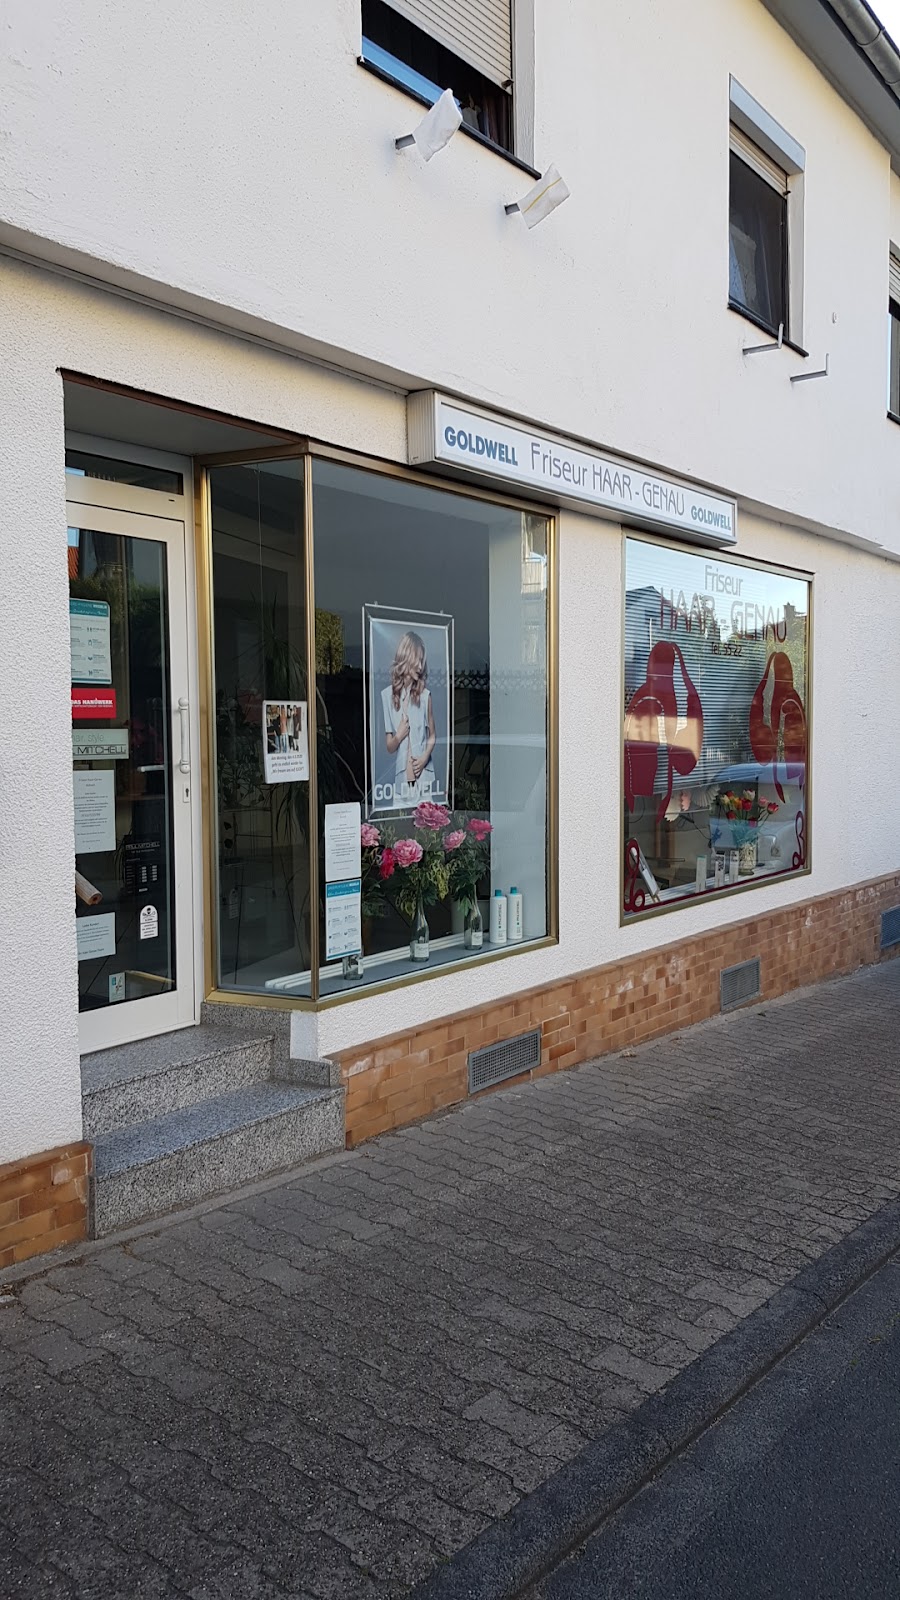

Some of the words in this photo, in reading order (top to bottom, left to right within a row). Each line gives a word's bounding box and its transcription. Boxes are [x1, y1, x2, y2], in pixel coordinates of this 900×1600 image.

[444, 426, 518, 466] GOLDWELL
[530, 442, 588, 487] Friseur
[690, 505, 732, 531] GOLDWELL
[704, 564, 743, 597] Friseur
